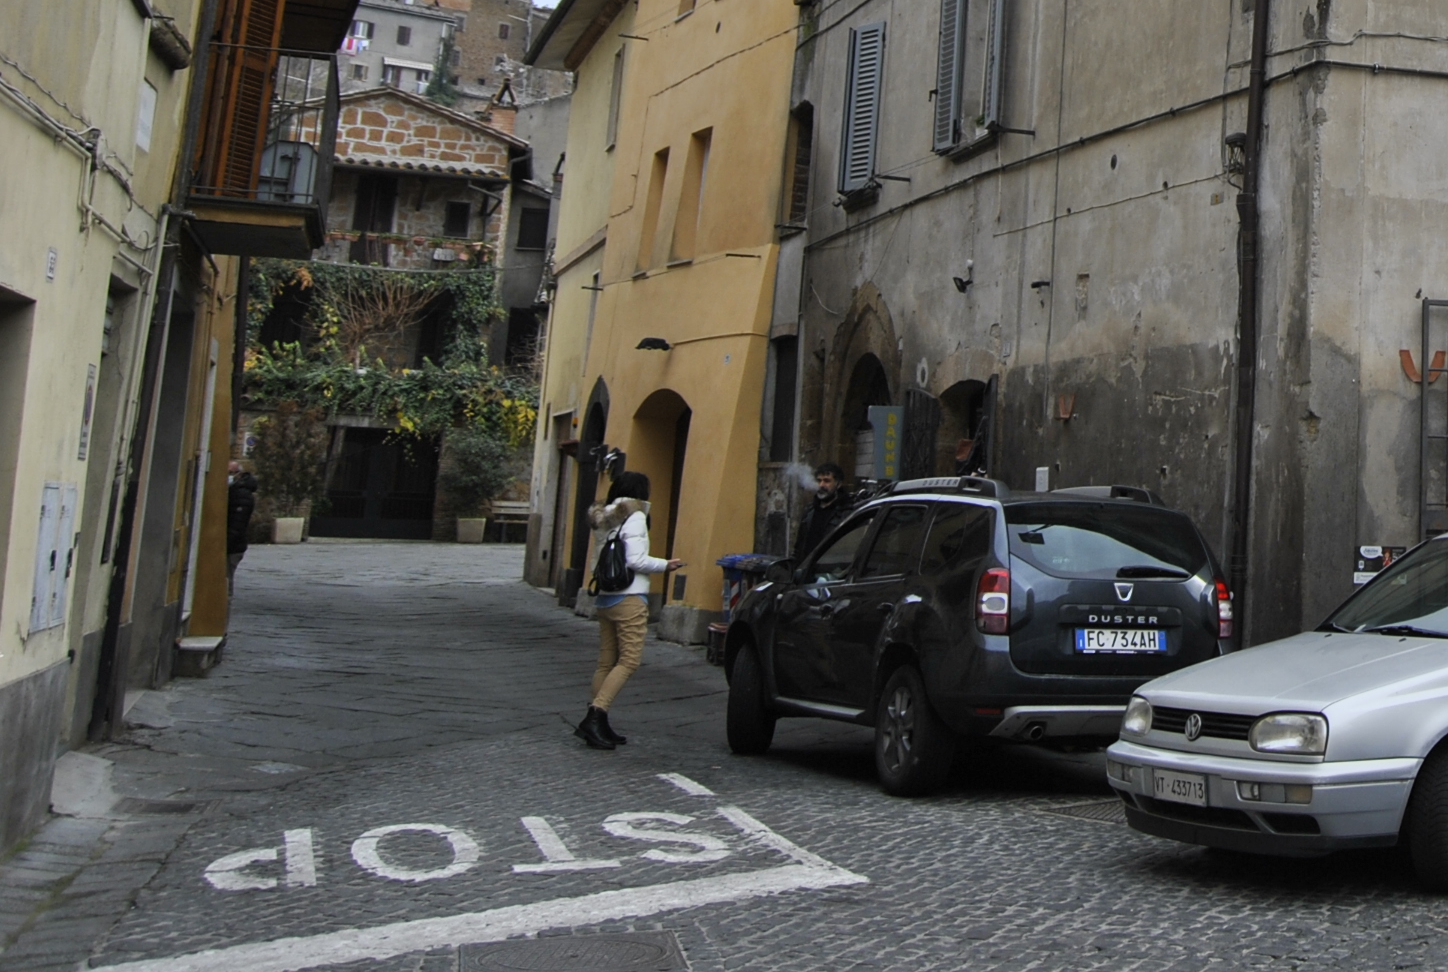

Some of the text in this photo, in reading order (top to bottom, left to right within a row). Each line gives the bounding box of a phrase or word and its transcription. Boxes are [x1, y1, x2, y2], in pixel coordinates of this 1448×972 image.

[922, 478, 959, 487] DUSTER
[1088, 614, 1158, 624] DUSTER
[203, 810, 732, 891] STOP
